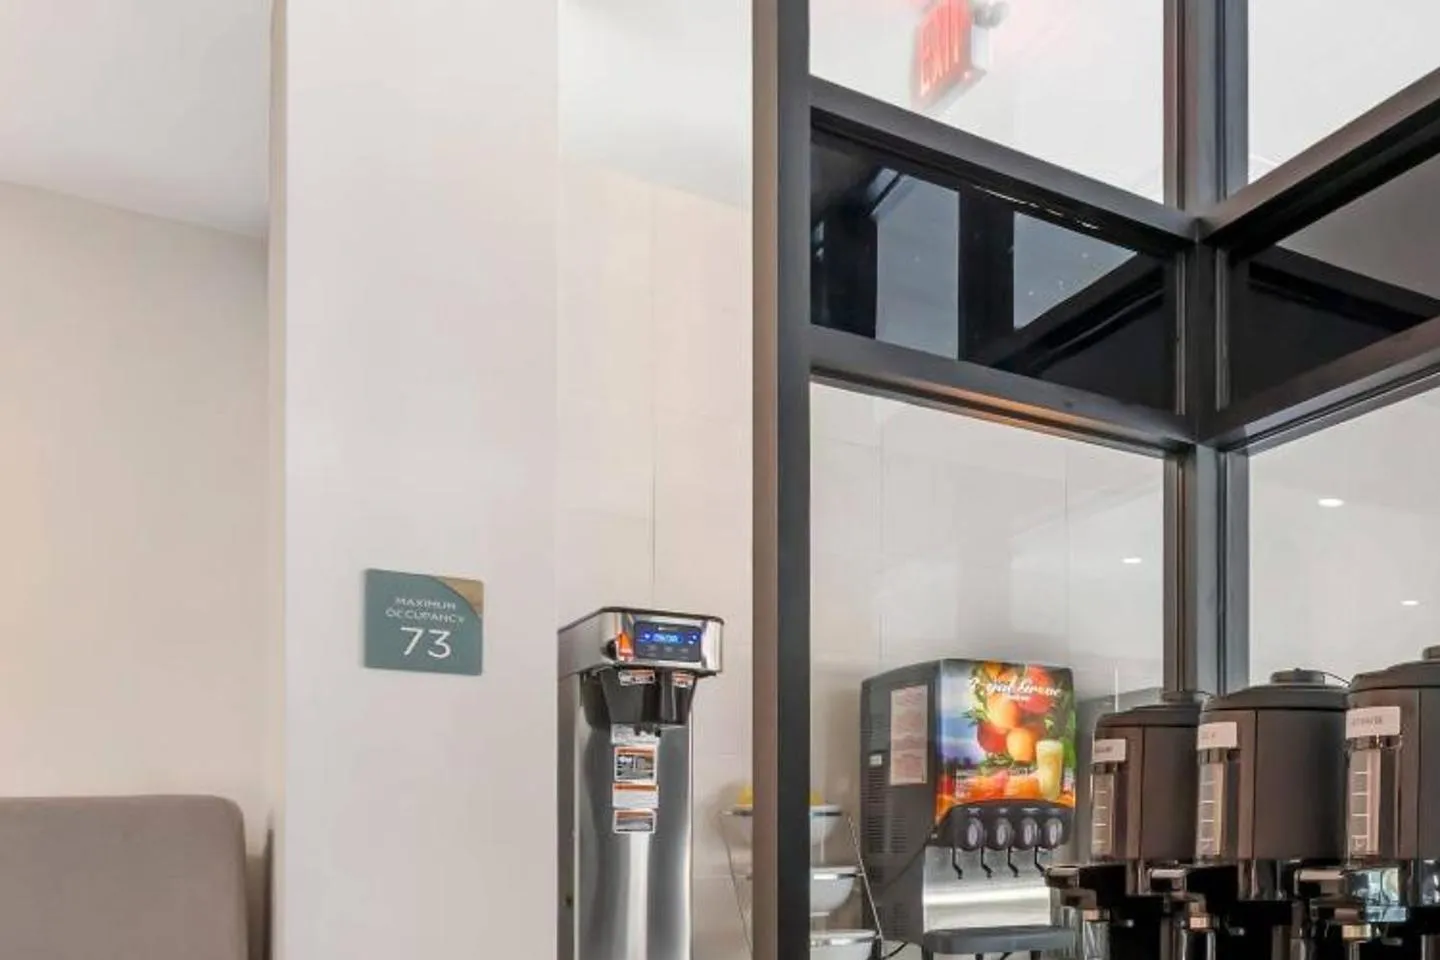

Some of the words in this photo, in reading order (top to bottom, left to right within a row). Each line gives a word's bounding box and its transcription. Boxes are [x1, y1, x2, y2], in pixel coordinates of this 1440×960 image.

[395, 597, 456, 610] MAXIMUM
[385, 607, 464, 623] OCCUPANCY
[400, 626, 451, 659] 73
